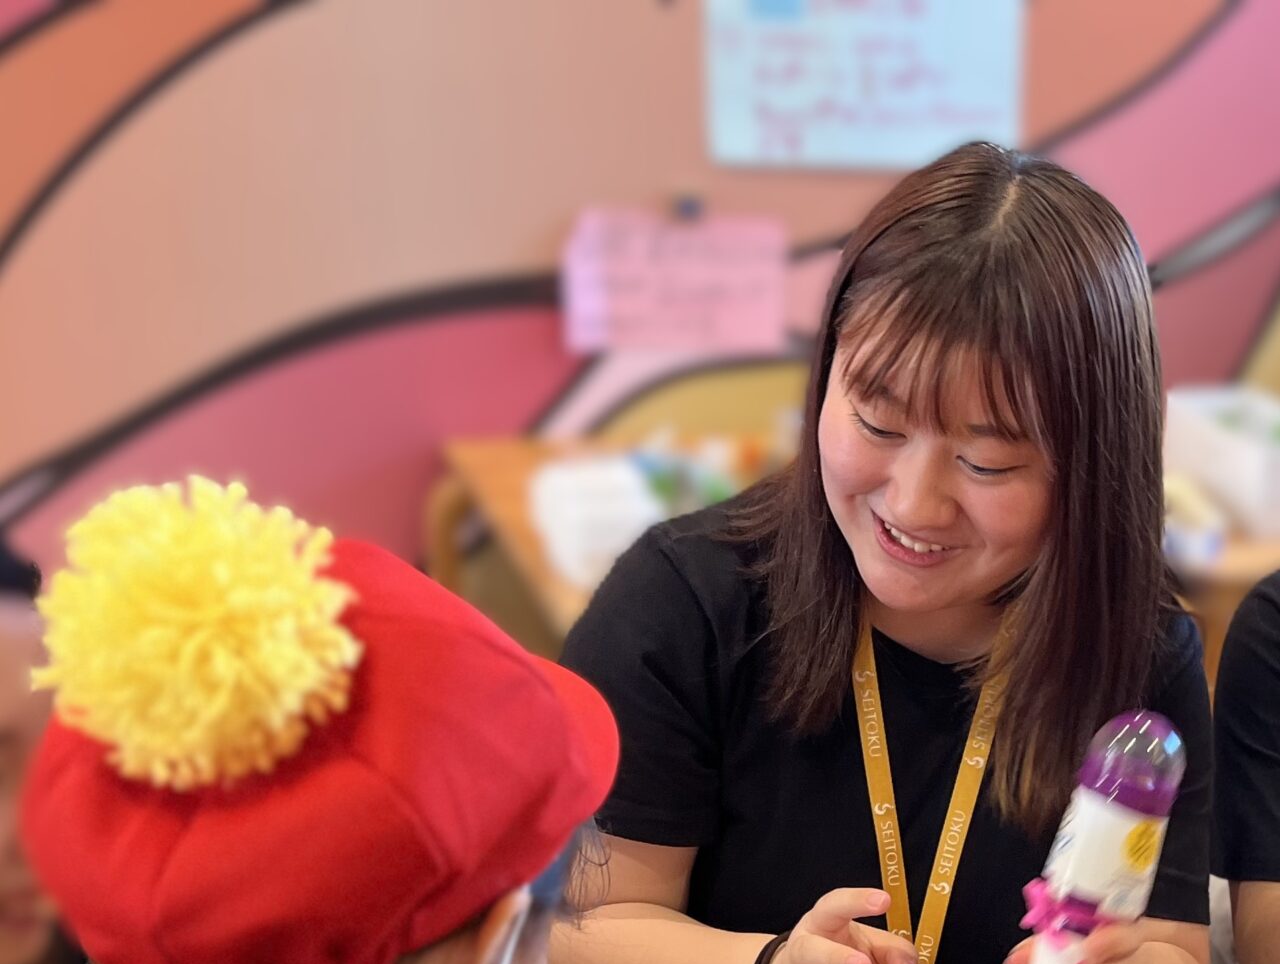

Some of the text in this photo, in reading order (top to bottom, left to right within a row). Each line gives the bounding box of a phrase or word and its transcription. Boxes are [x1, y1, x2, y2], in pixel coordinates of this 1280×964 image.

[860, 688, 882, 758] SEITOKU
[880, 821, 901, 887] SEITOKU
[939, 810, 966, 876] SEITOKU
